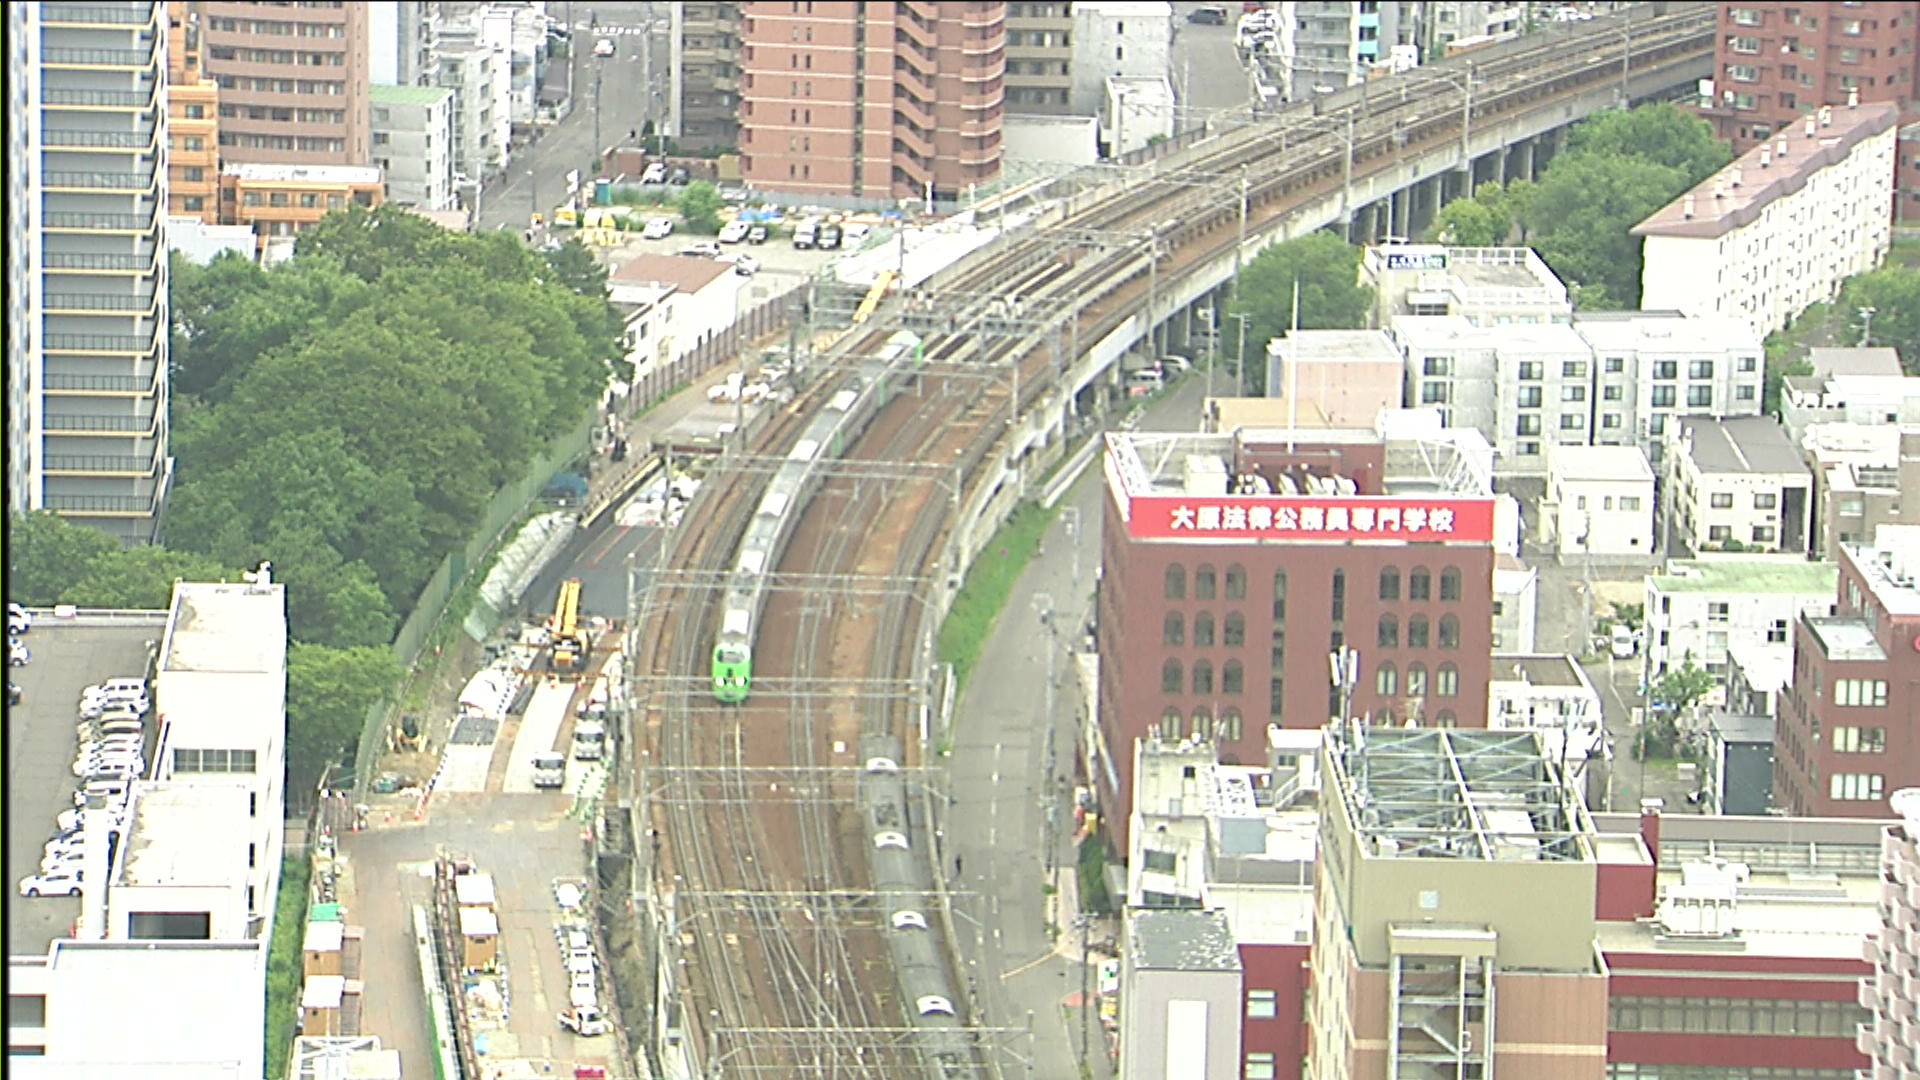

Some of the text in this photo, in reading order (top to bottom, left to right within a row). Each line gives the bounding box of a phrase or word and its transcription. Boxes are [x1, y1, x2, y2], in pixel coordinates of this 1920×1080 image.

[1170, 505, 1455, 532] 大原法律公務員専門学校
